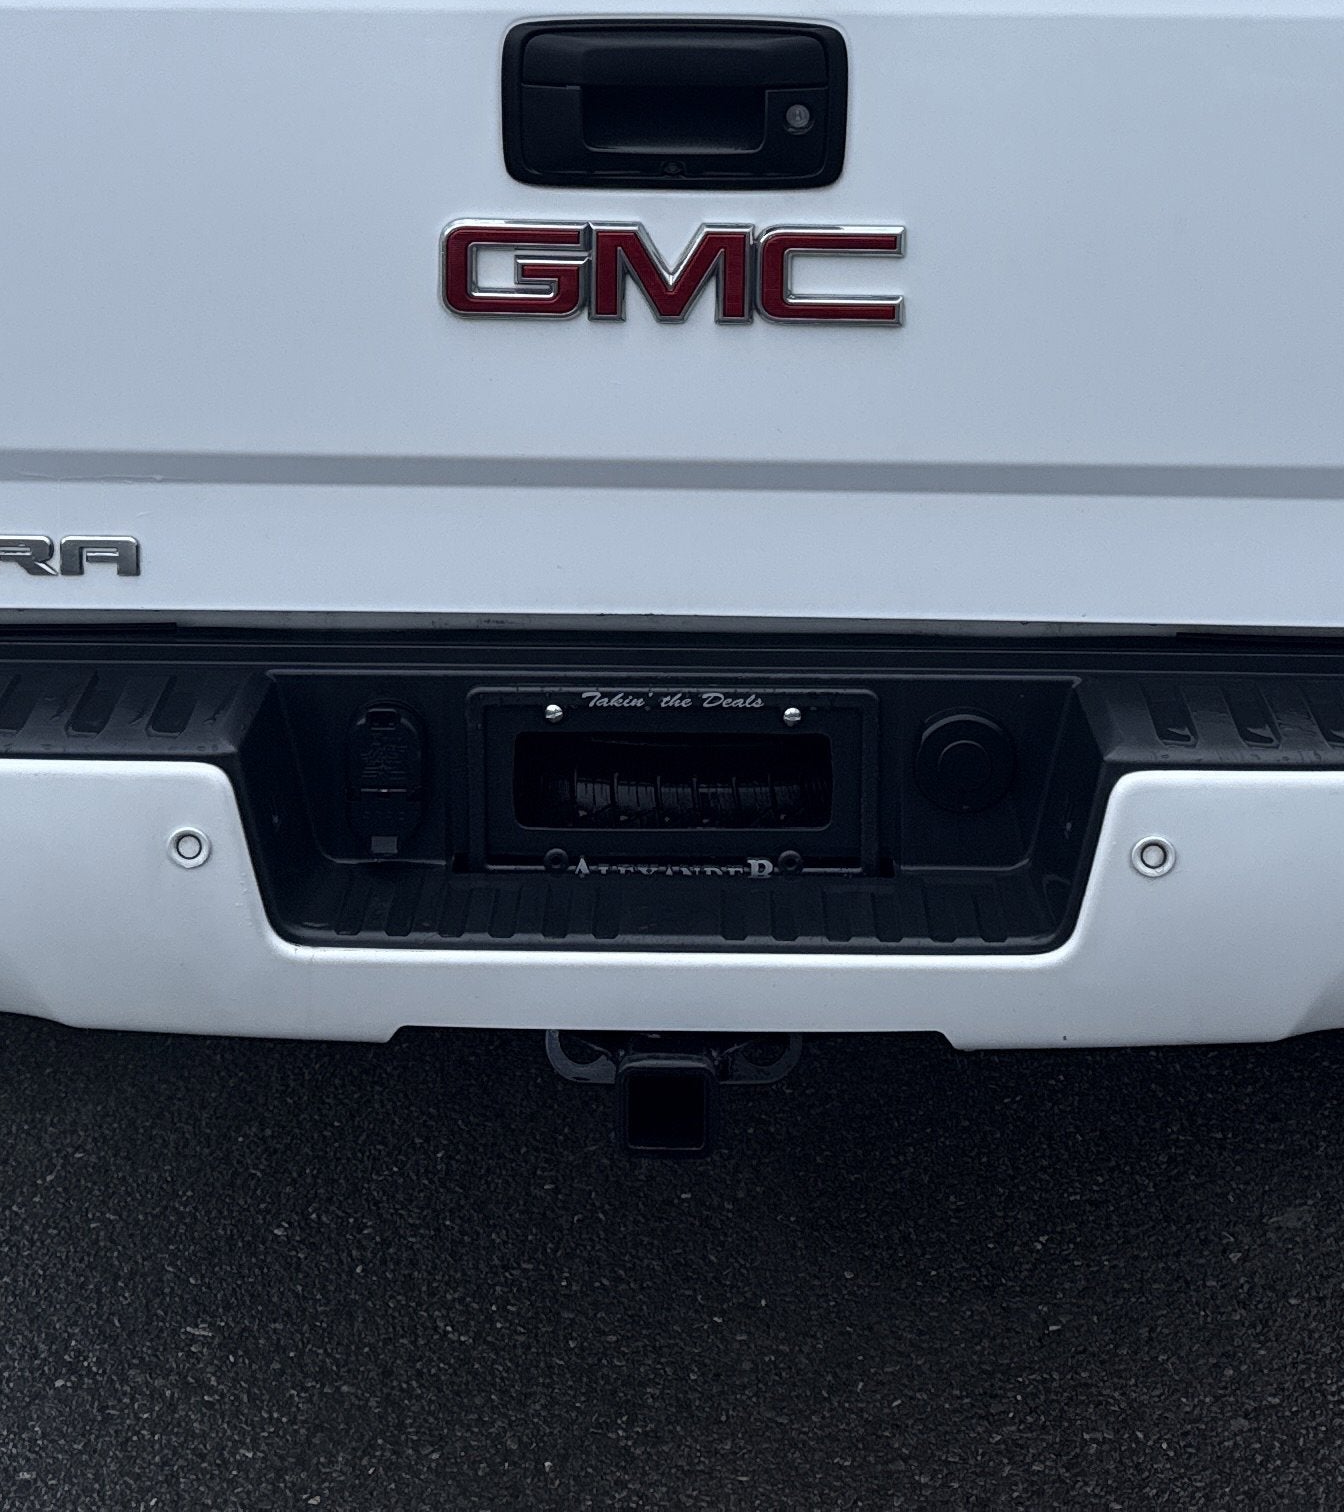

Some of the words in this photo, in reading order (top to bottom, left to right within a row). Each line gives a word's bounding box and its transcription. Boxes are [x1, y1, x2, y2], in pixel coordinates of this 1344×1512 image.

[438, 217, 906, 327] GMC
[581, 690, 654, 708] Takin'
[660, 692, 693, 708] the
[701, 692, 765, 708] Deals
